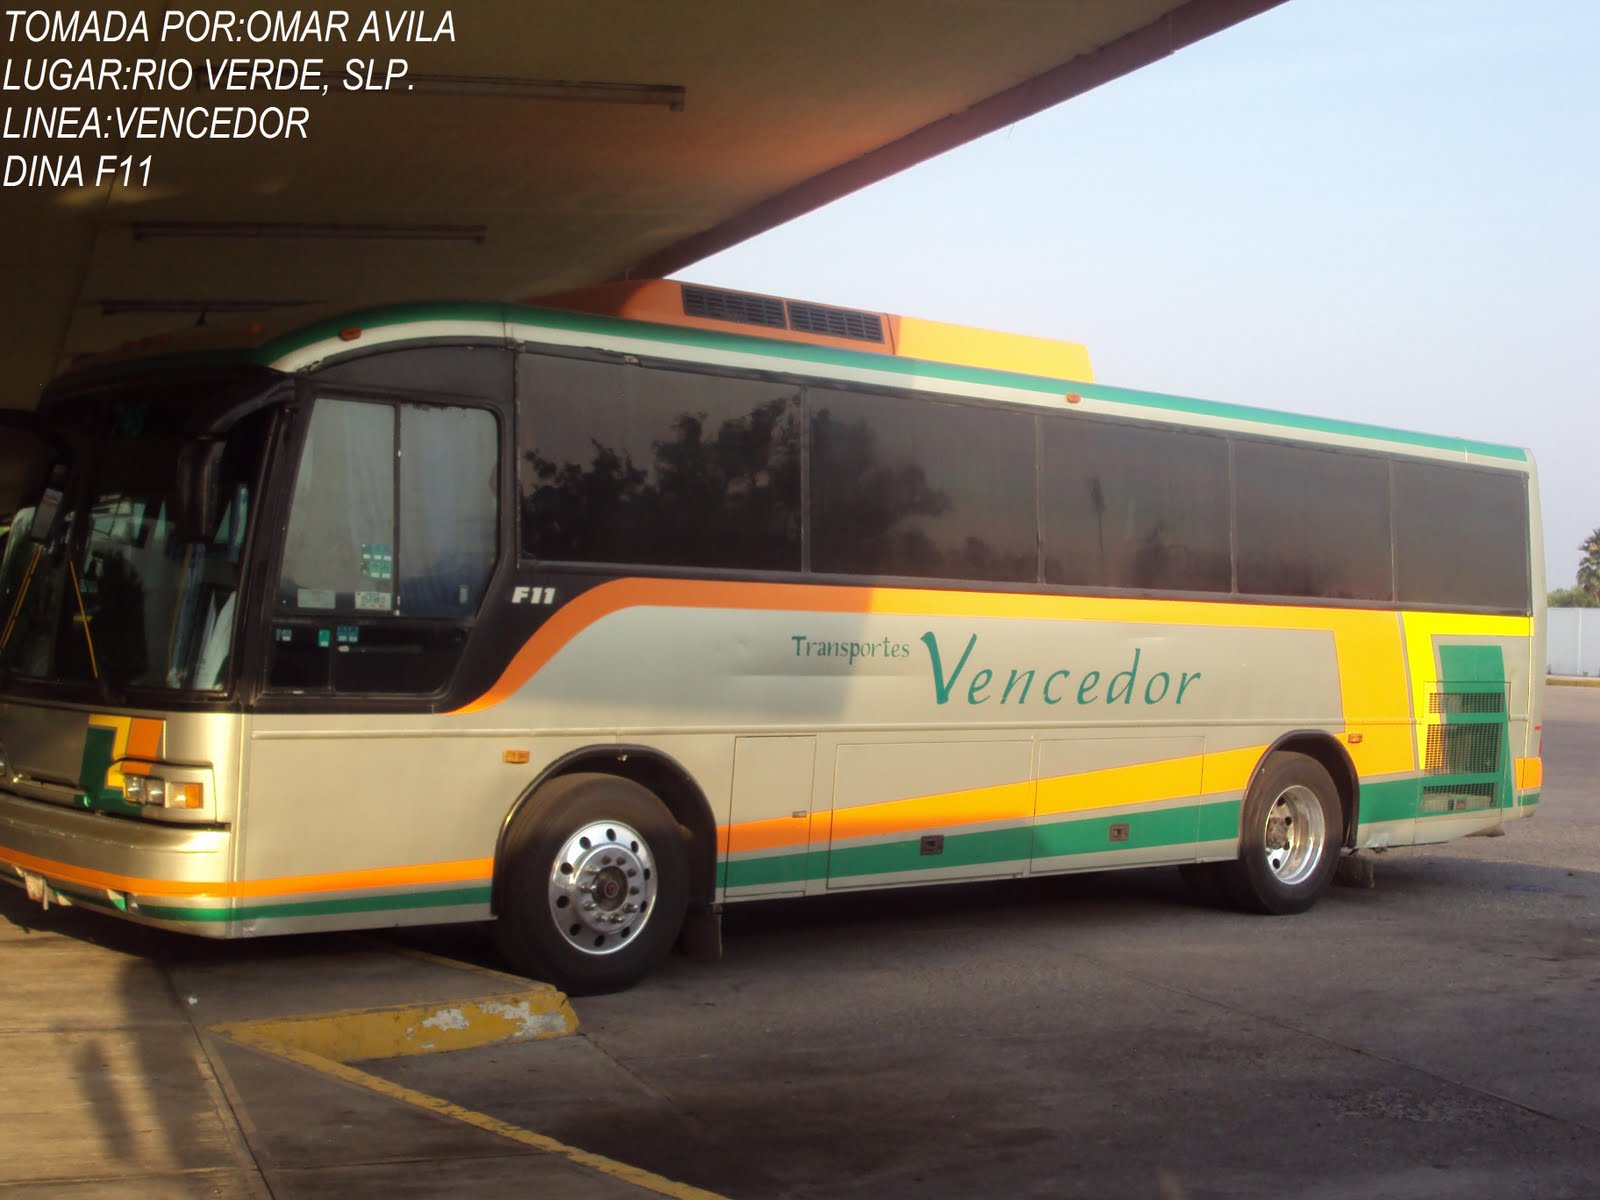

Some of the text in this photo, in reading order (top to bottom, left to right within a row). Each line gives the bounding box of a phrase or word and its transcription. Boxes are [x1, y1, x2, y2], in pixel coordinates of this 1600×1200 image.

[512, 586, 556, 605] F11
[791, 631, 1202, 705] Transportes Vencedor
